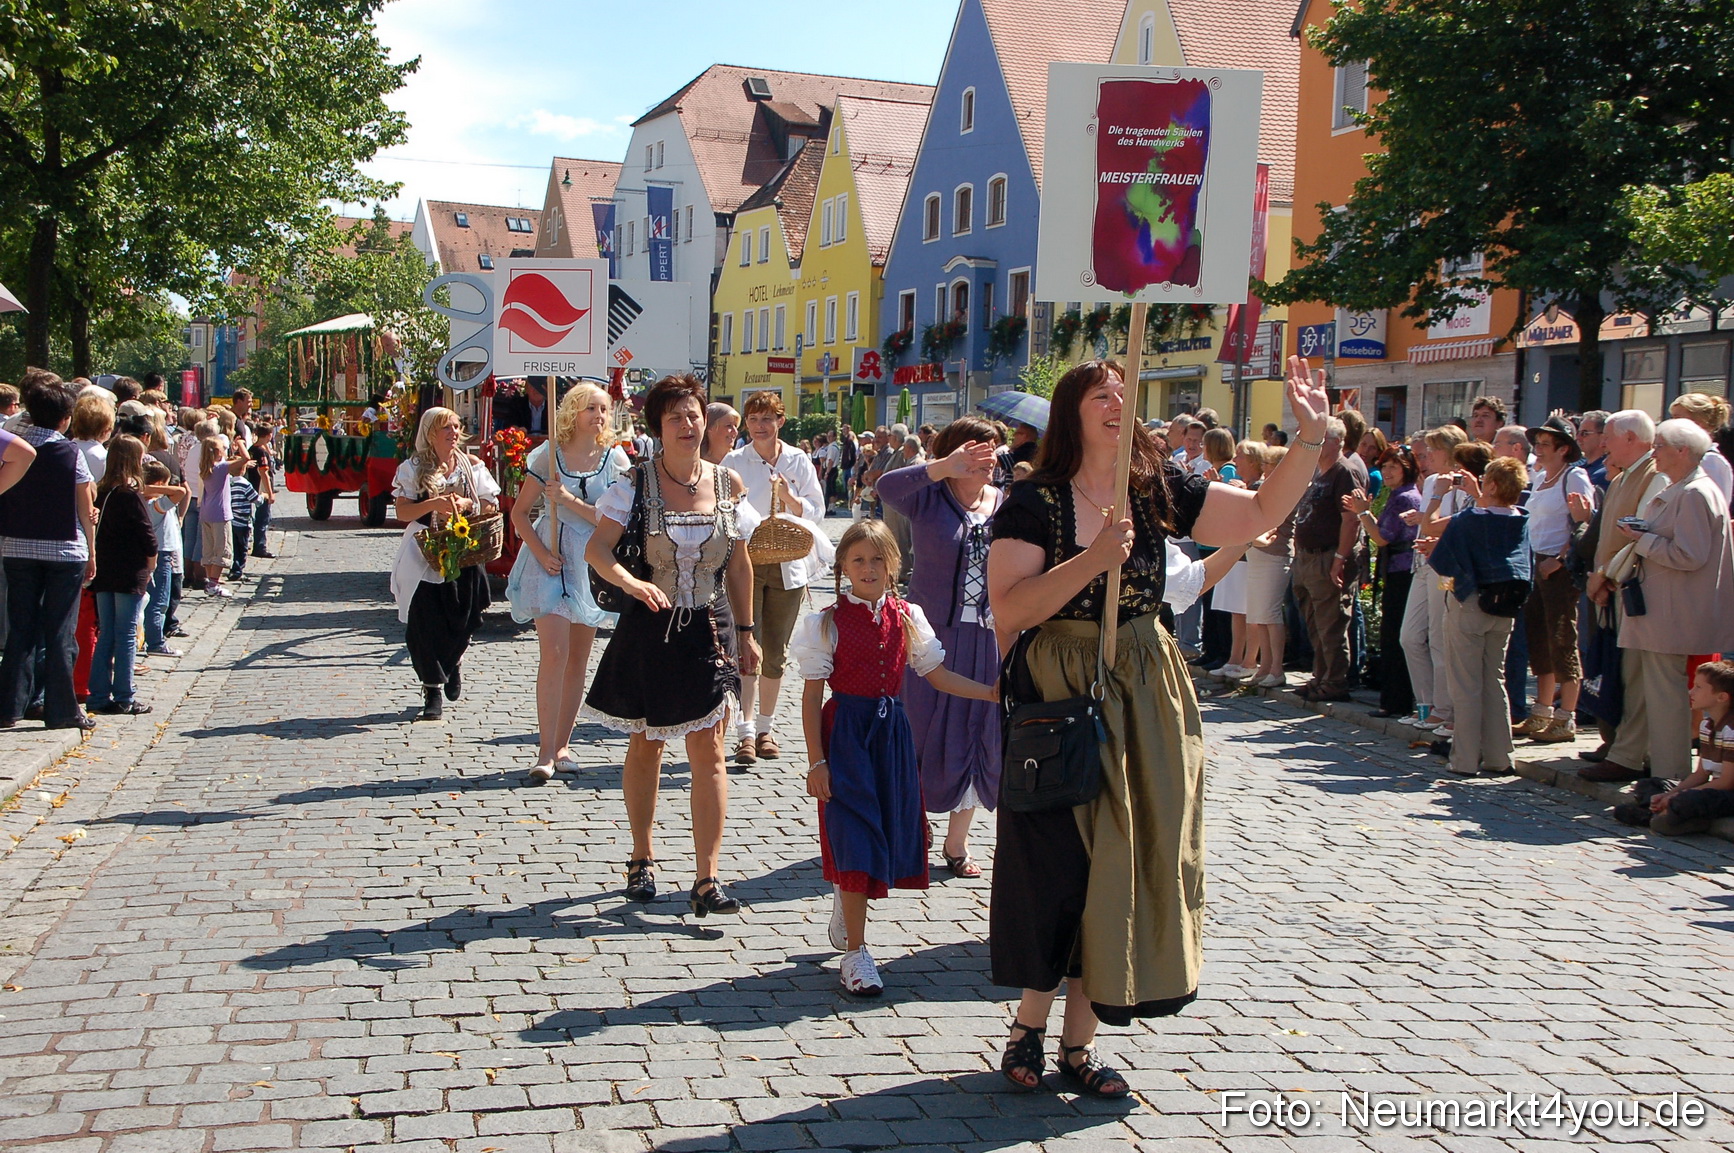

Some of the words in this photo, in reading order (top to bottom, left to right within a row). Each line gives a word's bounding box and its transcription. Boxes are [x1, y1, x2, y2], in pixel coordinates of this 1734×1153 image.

[1108, 126, 1124, 135] Die
[1125, 128, 1170, 137] tragenden
[1172, 127, 1203, 137] Säulen
[1117, 137, 1134, 146] des
[1135, 138, 1185, 148] Handwerks
[1099, 171, 1203, 185] MEISTERFRAUEN
[749, 285, 768, 303] HOTEL
[1350, 315, 1376, 331] DER
[1301, 331, 1318, 351] DER
[1273, 323, 1281, 375] KINO
[1341, 346, 1382, 355] Reisebüro
[523, 361, 576, 372] FRISEUR
[1533, 372, 1540, 383] 6
